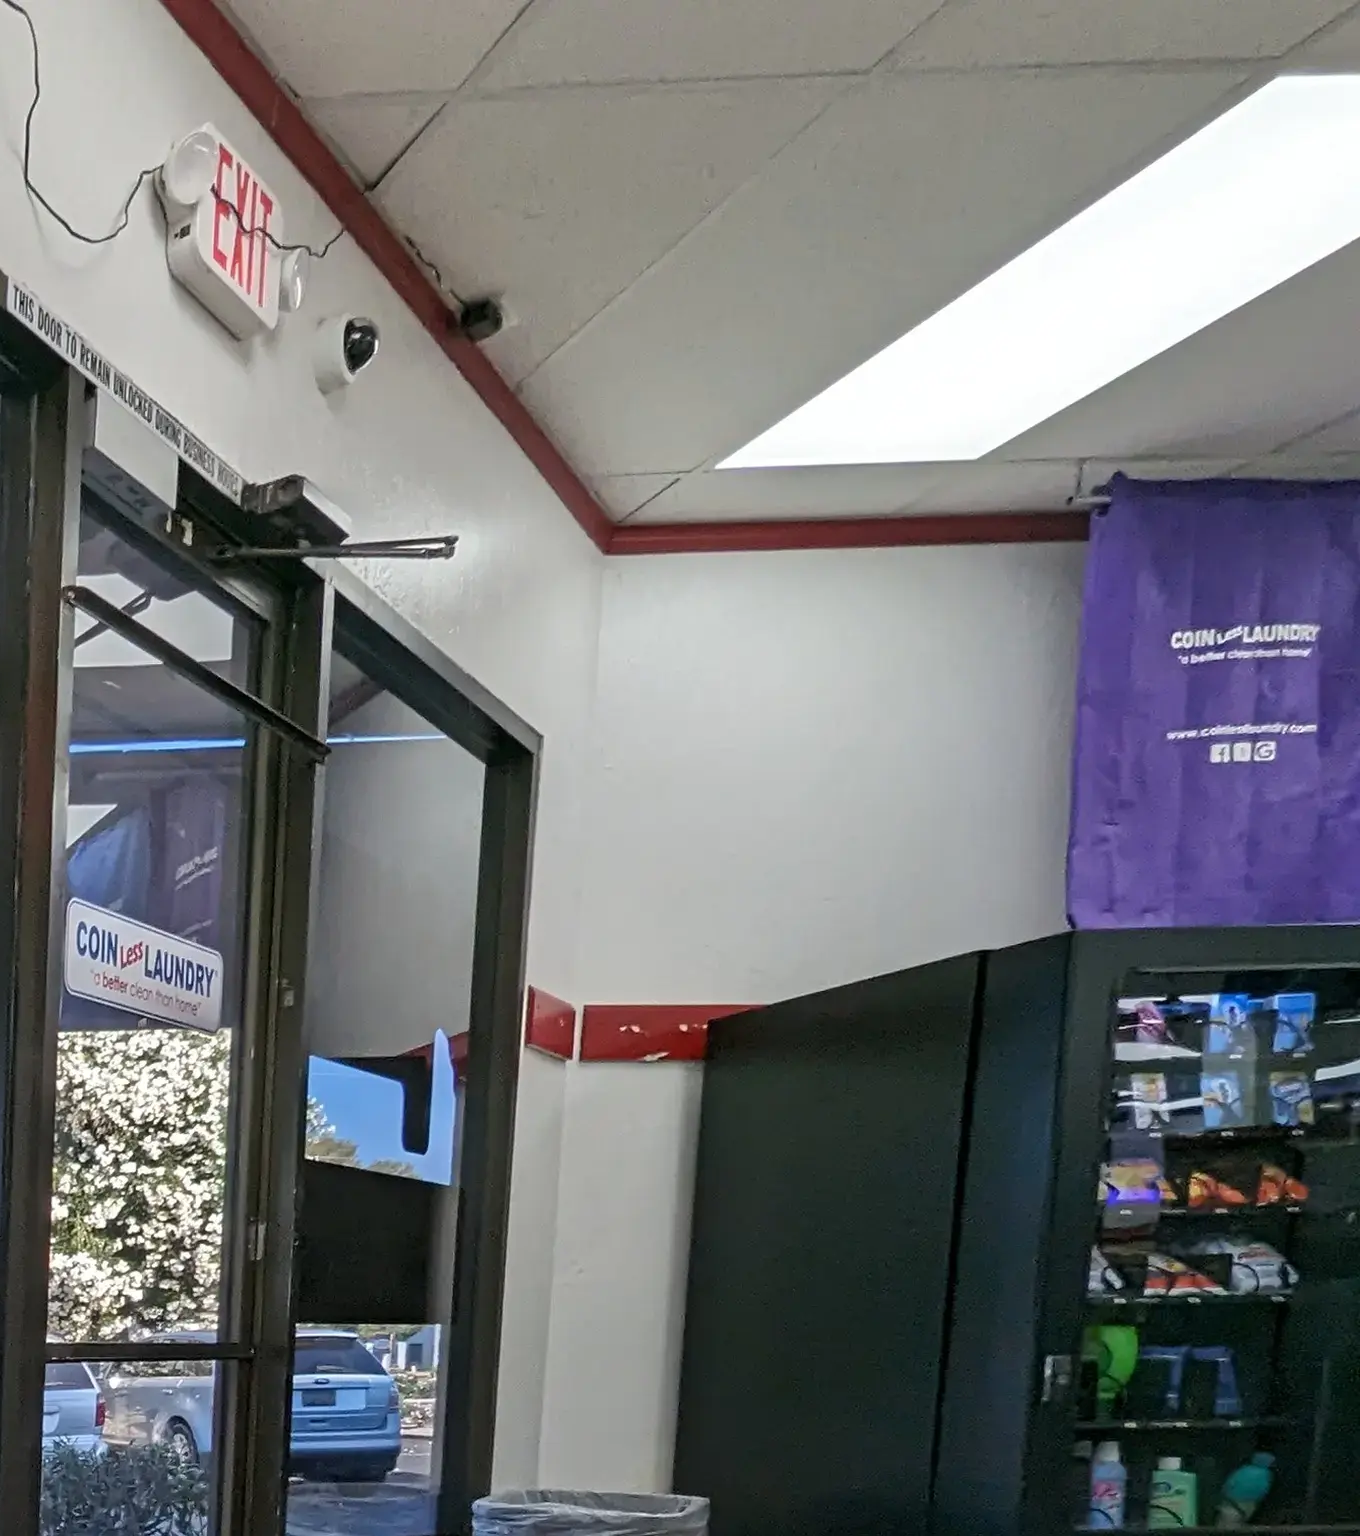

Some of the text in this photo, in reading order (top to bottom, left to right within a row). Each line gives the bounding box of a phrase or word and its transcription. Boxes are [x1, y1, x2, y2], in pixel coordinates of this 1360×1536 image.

[211, 142, 275, 309] EXIT
[13, 284, 35, 324] THIS
[37, 305, 62, 349] DOOR
[65, 329, 77, 360] TO
[80, 343, 111, 390] REMAIN
[113, 371, 153, 424] UNLOCKED
[1170, 629, 1216, 649] COIN
[1242, 624, 1321, 643] LAUNDRY
[76, 921, 118, 967] COIN
[144, 945, 215, 998] LAUNDRY
[102, 972, 128, 992] better
[129, 981, 153, 1001] clean
[155, 988, 174, 1008] than
